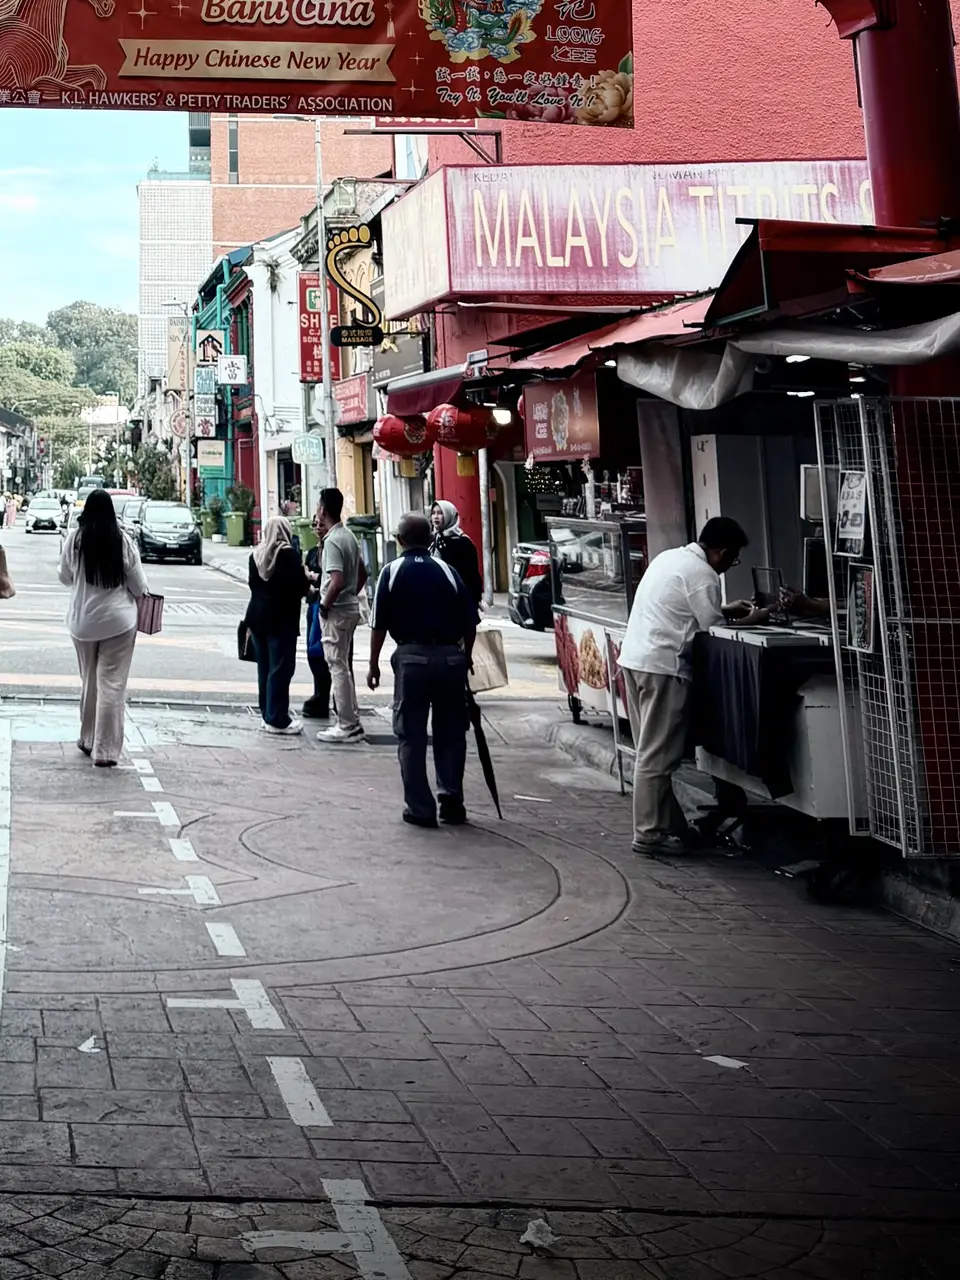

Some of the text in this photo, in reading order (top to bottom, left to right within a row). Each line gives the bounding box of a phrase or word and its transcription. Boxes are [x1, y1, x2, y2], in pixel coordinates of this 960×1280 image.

[544, 24, 606, 46] LOONG
[134, 47, 381, 72] Happy Chinese New Year
[550, 45, 598, 64] KEE
[61, 92, 393, 112] K.L. HAWKERS' & PETTY TRADERS' ASSOCIATION
[435, 86, 462, 109] Try
[486, 88, 528, 109] You'll
[530, 91, 565, 108] Love
[473, 186, 677, 269] MALAYSIA
[301, 313, 338, 329] SHE
